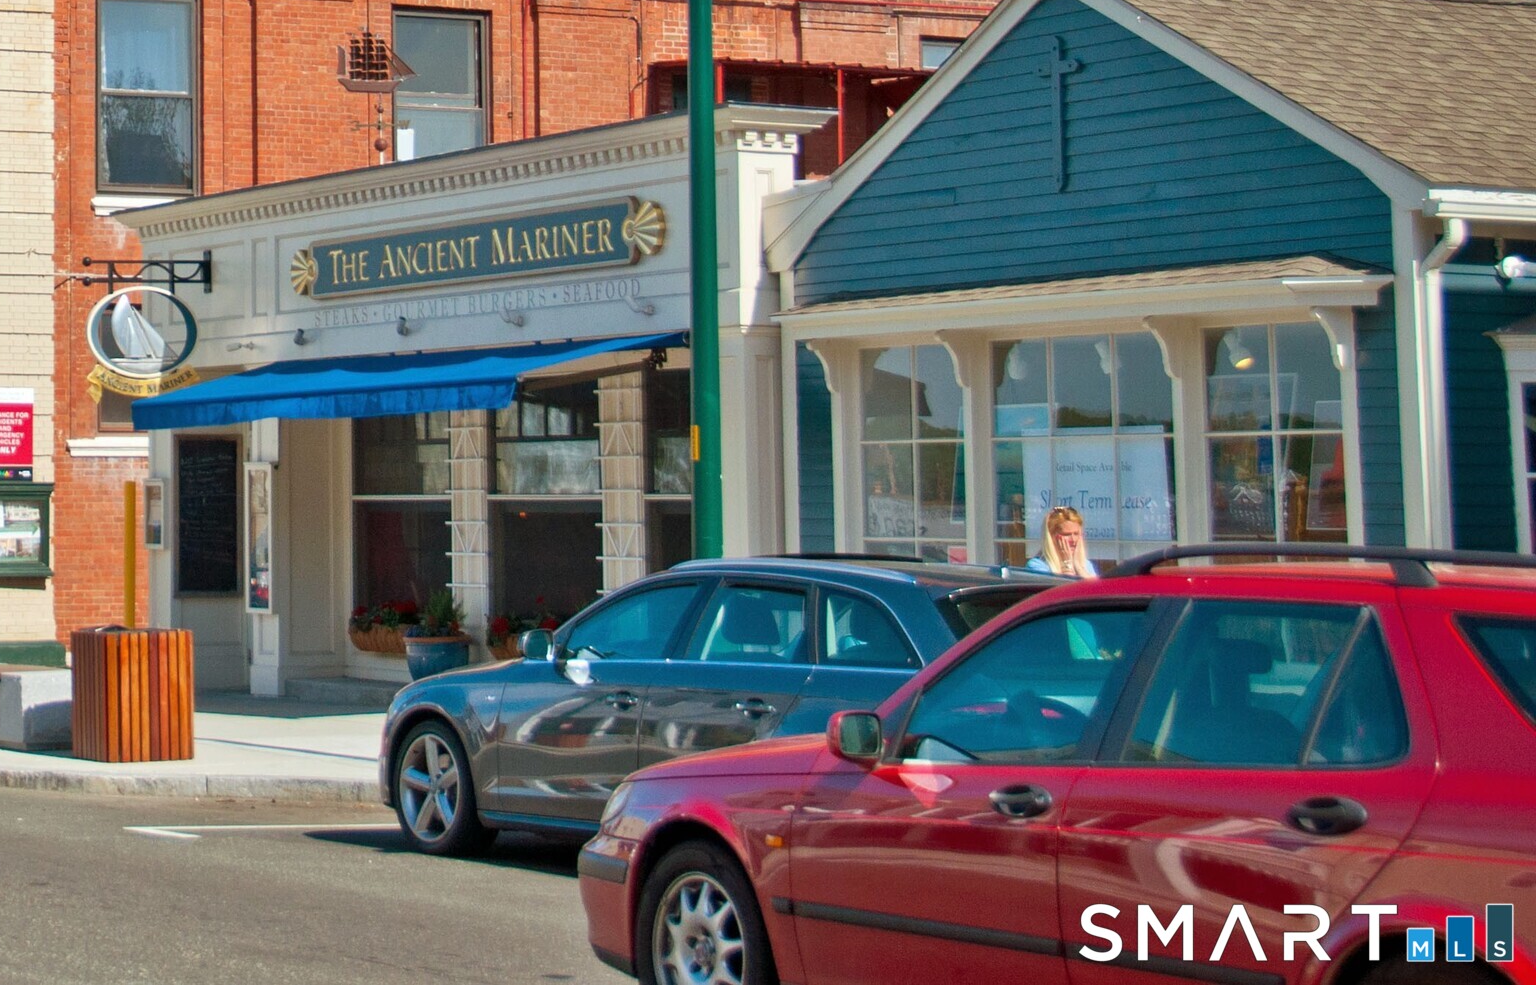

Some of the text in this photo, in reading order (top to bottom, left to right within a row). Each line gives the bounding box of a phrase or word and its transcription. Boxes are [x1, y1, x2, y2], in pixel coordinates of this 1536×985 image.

[328, 217, 615, 285] THE ANCIENT MARINER
[313, 278, 642, 328] STEAKS GOURMET BURGERS SEAFOOD
[98, 369, 193, 394] ANCIENT MARINER
[1077, 461, 1097, 474] Space
[1099, 461, 1132, 472] Avable
[1077, 490, 1113, 509] Term
[1121, 493, 1152, 510] ease
